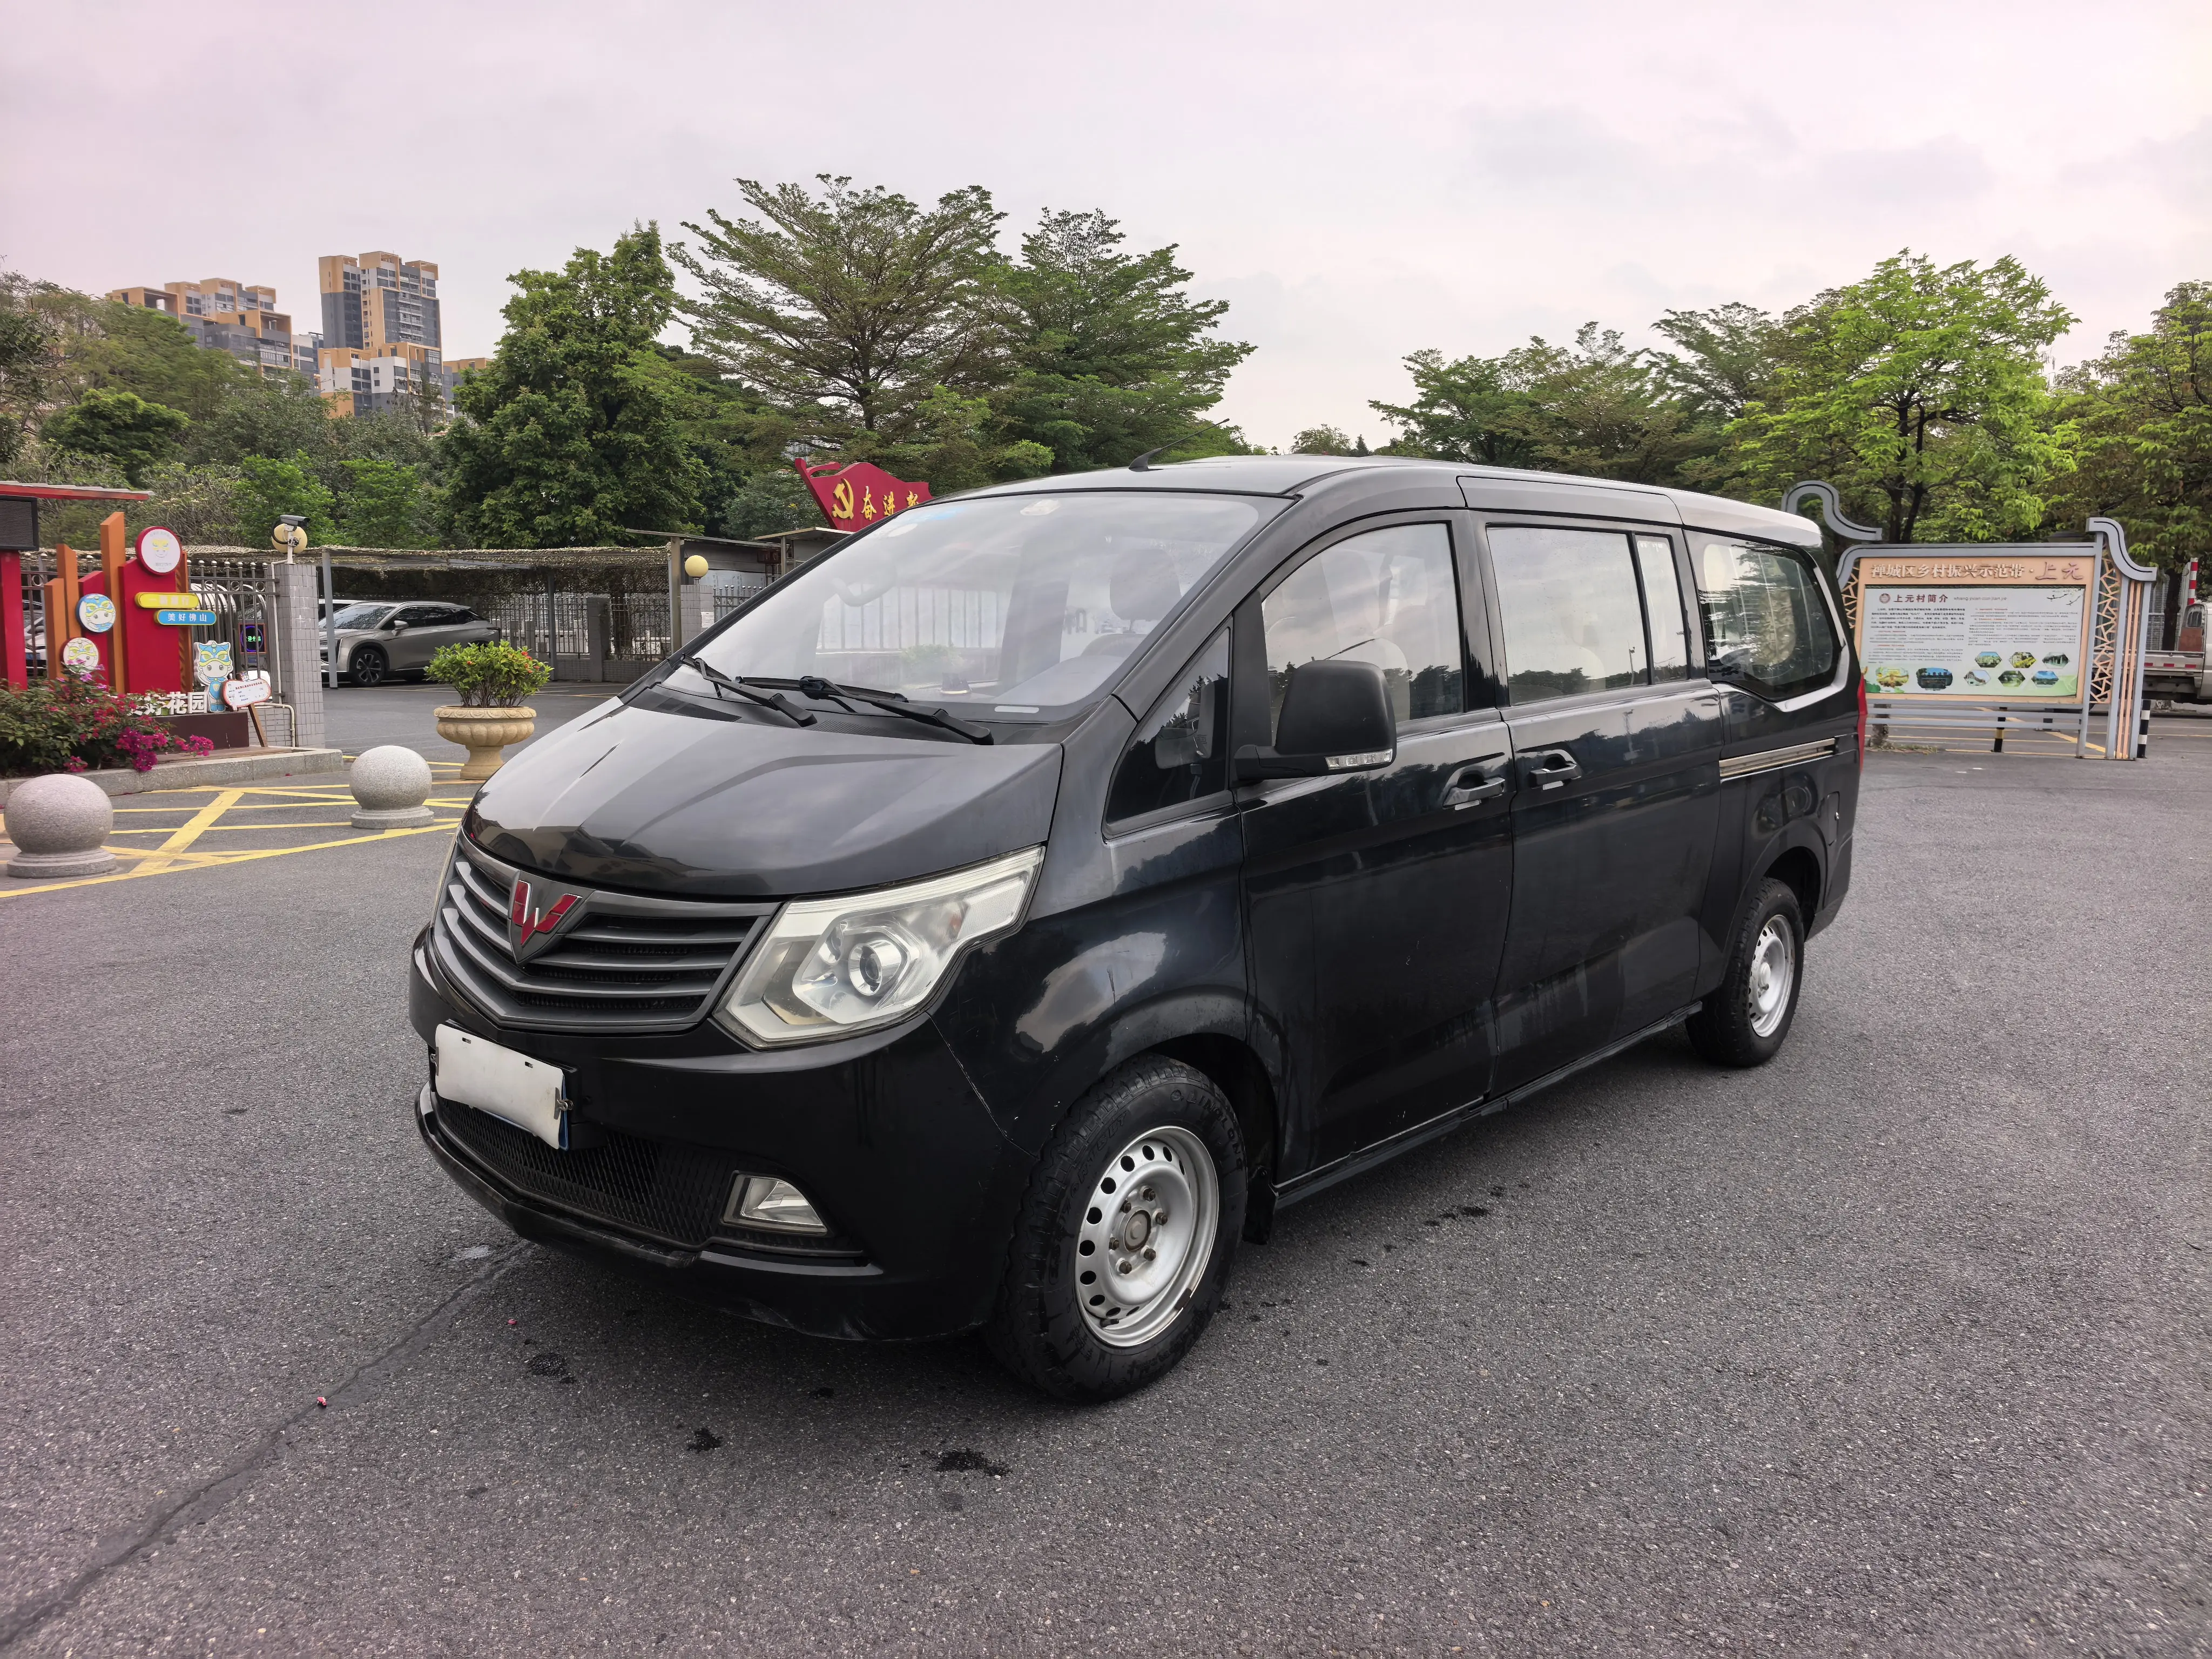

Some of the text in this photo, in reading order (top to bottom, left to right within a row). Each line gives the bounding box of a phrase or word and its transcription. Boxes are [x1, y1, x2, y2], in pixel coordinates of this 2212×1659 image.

[1893, 594, 1948, 603] 上元村简介
[167, 612, 207, 622] 美好佛山
